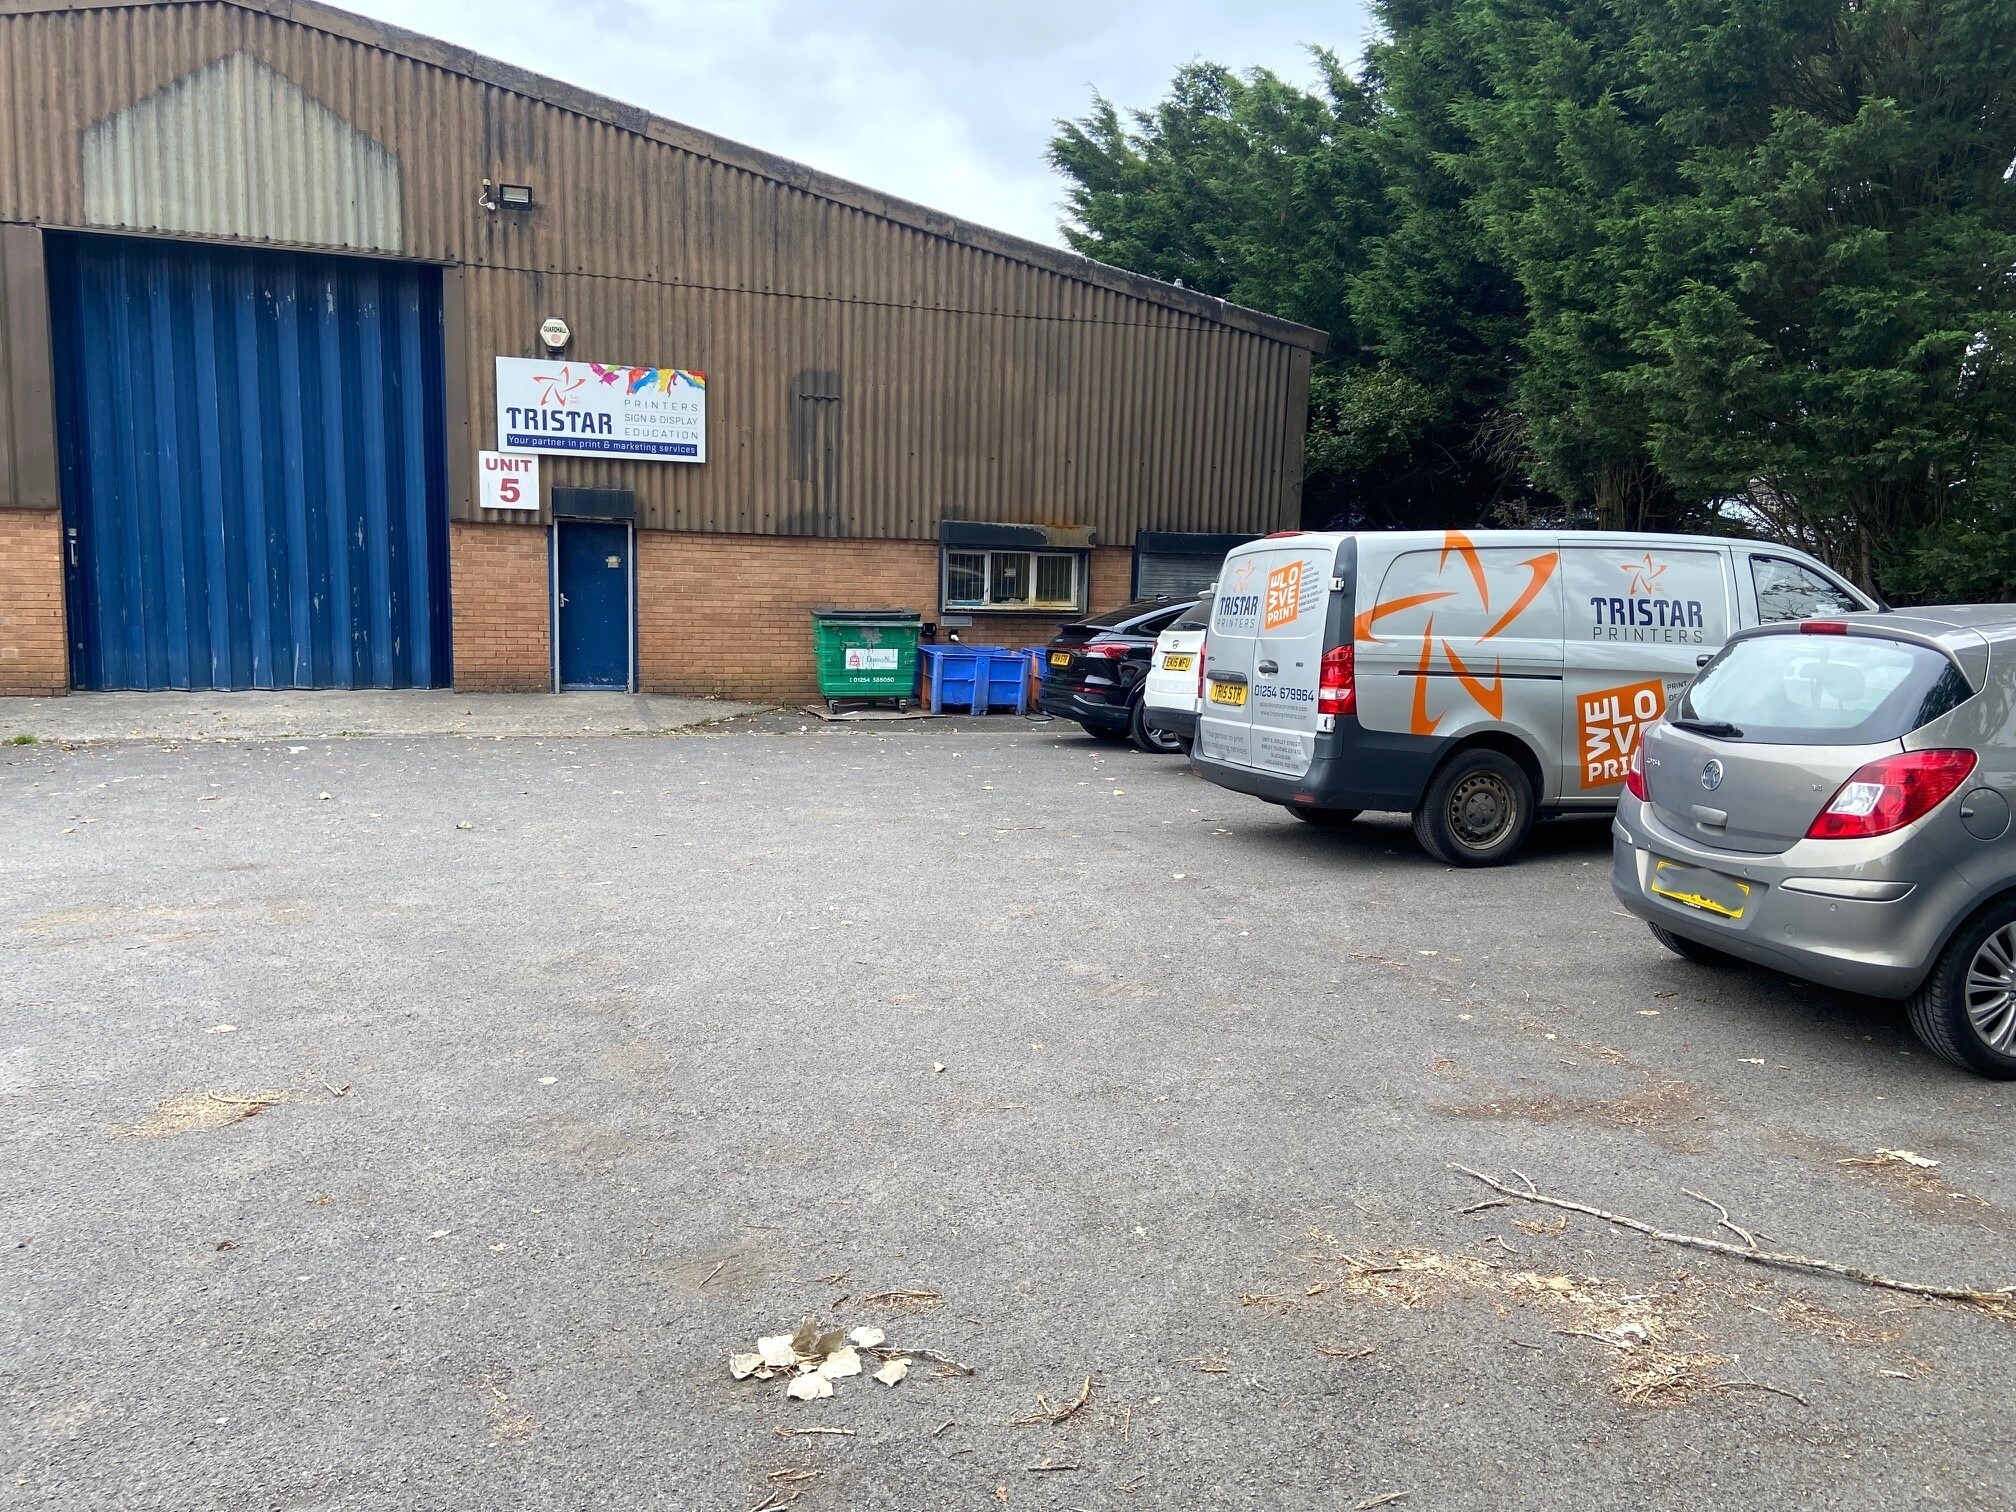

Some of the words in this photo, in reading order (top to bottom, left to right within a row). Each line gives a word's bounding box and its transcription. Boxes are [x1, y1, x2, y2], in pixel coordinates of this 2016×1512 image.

[624, 399, 698, 412] PRINTERS
[506, 407, 612, 434] TRISTAR
[624, 414, 646, 422] SIGN
[650, 415, 656, 424] &
[660, 416, 698, 426] DISPLAY
[624, 428, 698, 440] EDUCATION
[508, 435, 529, 444] Your
[532, 438, 565, 447] partner
[568, 438, 577, 446] in
[580, 440, 600, 450] print
[604, 441, 610, 449] &
[613, 442, 656, 453] marketing
[659, 444, 695, 454] services
[486, 458, 532, 472] UNIT
[500, 478, 520, 502] 5
[1220, 596, 1258, 616] TRISTAR
[1267, 604, 1296, 625] PRINT
[1590, 598, 1703, 628] TRISTAR
[1216, 618, 1255, 628] PRINTERS
[1593, 626, 1703, 644] PRINTERS
[1228, 686, 1242, 701] STR
[1254, 684, 1277, 698] 01254
[1280, 687, 1314, 702] 679964
[1667, 681, 1687, 690] PRINT
